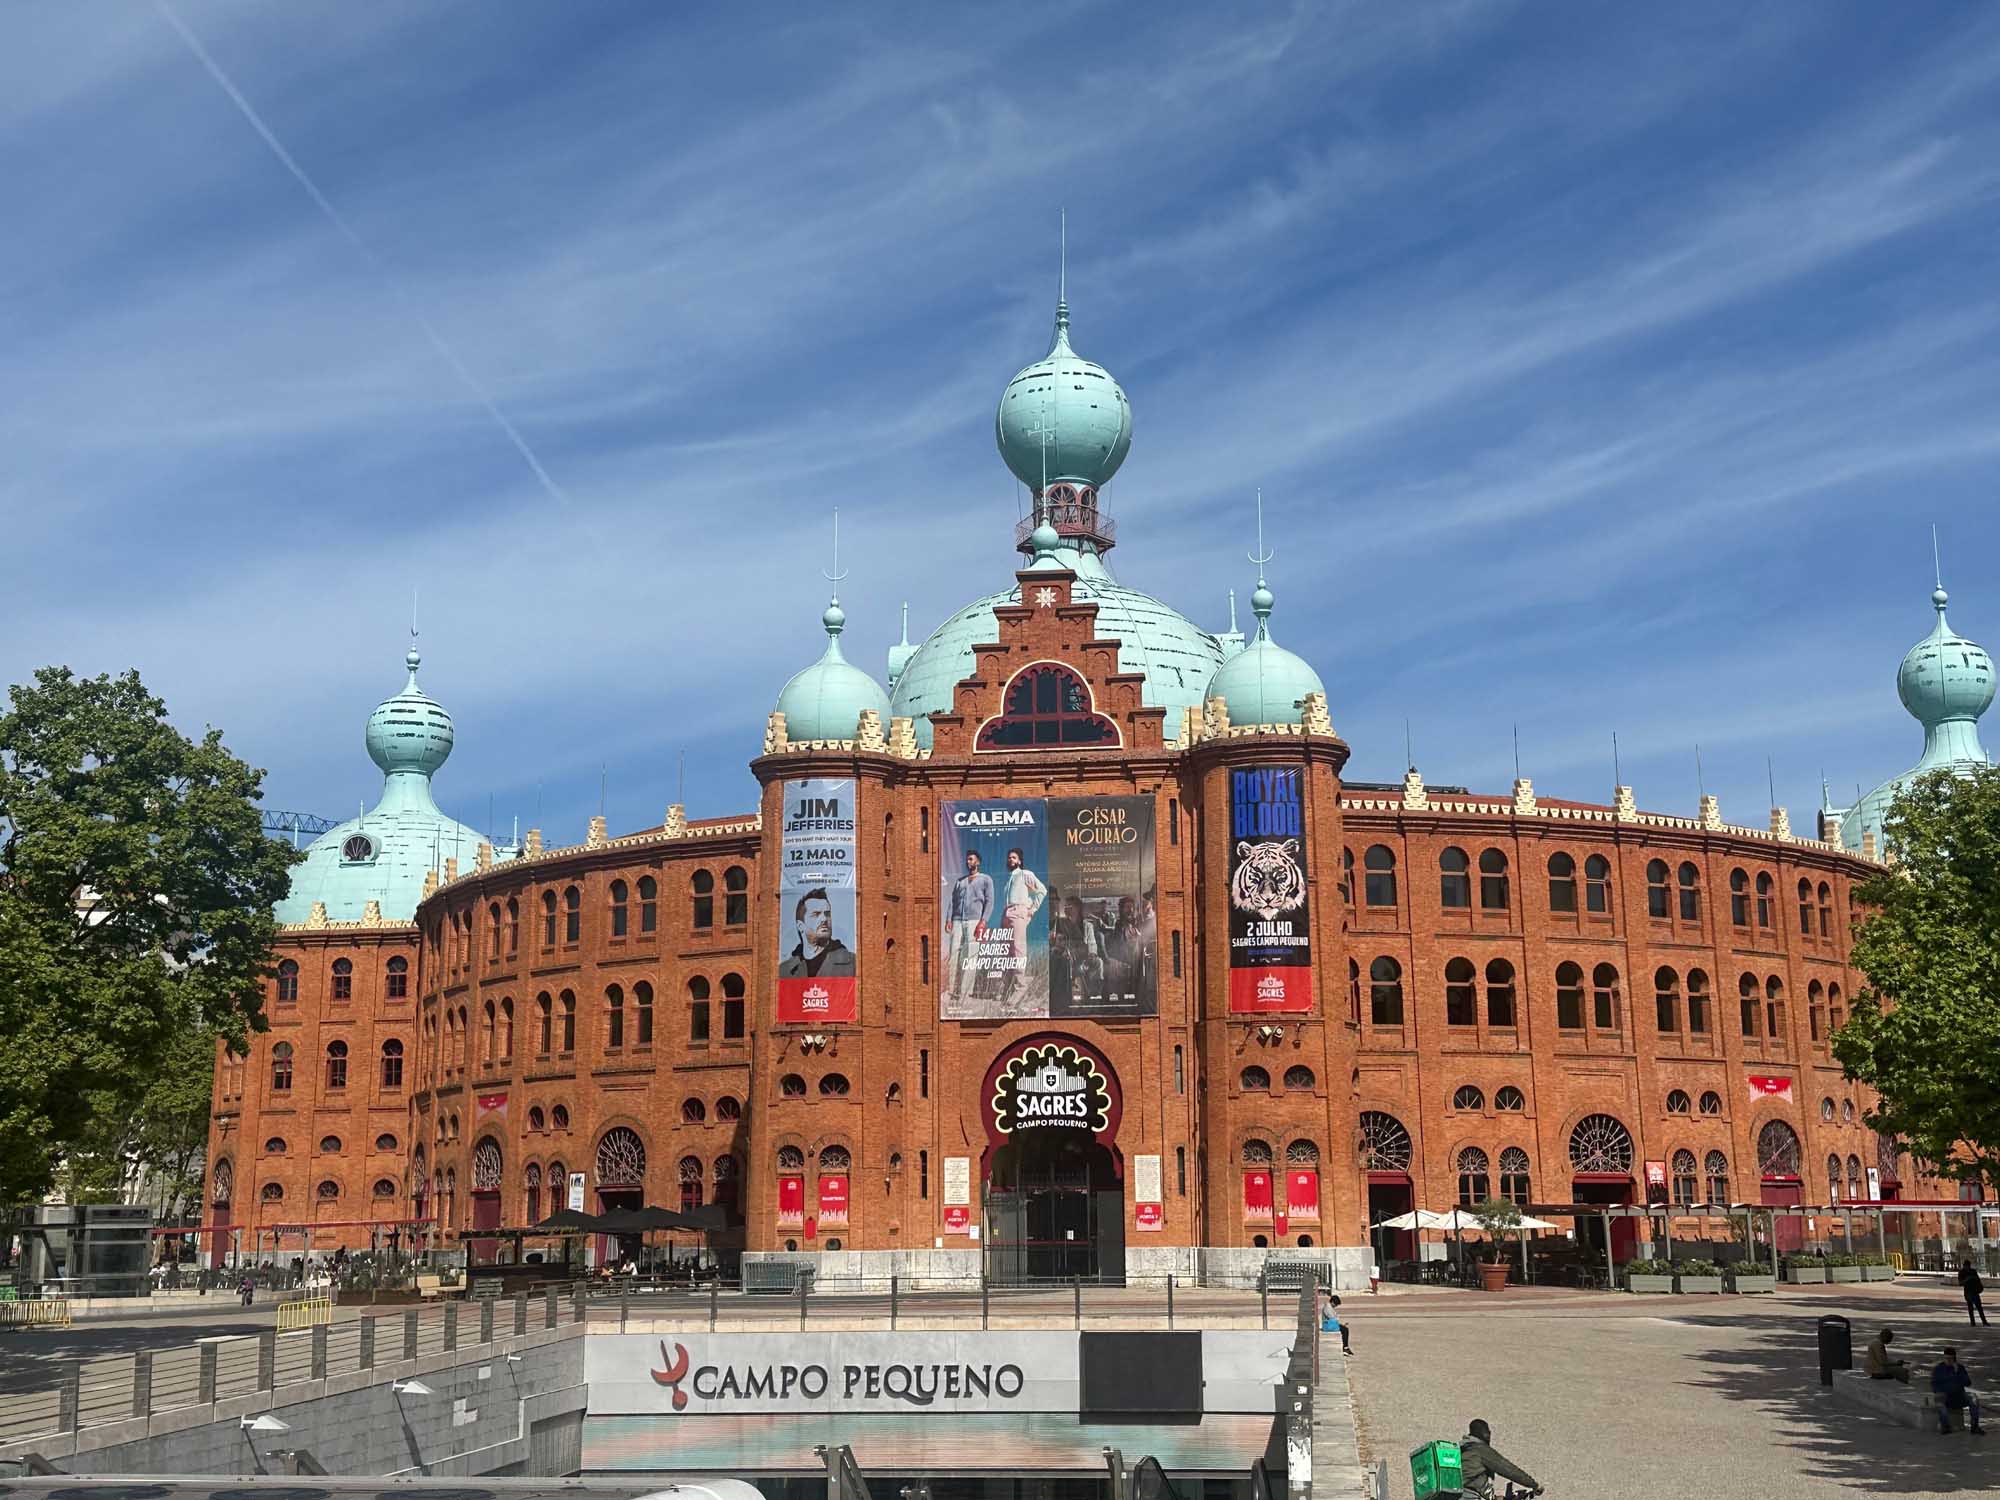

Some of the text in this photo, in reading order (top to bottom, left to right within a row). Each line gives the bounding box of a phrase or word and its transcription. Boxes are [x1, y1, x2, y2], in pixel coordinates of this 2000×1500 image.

[1234, 767, 1297, 803] ROYAL
[793, 799, 839, 819] JIM
[1077, 806, 1126, 825] CÉSAR
[953, 810, 1035, 826] CALEMA
[1234, 803, 1299, 838] BLOOD
[784, 820, 854, 832] JEFFERIES
[1066, 825, 1137, 845] MOURÃO
[790, 849, 846, 861] 12 MAIO
[977, 927, 1015, 941] 14 ABRIL
[1247, 921, 1292, 937] 2 JULHO
[1232, 936, 1309, 947] SAGRES CAMPO PEQUENO
[979, 944, 1010, 956] SAGRES
[962, 956, 1028, 971] CAMPO PEQUENO
[1257, 987, 1285, 998] SAGRES
[802, 998, 829, 1008] SAGRES
[1016, 1093, 1088, 1118] SAGRES
[1016, 1119, 1088, 1129] CAMPO PEQUENO
[692, 1364, 1024, 1405] CAMPO PEQUENO
